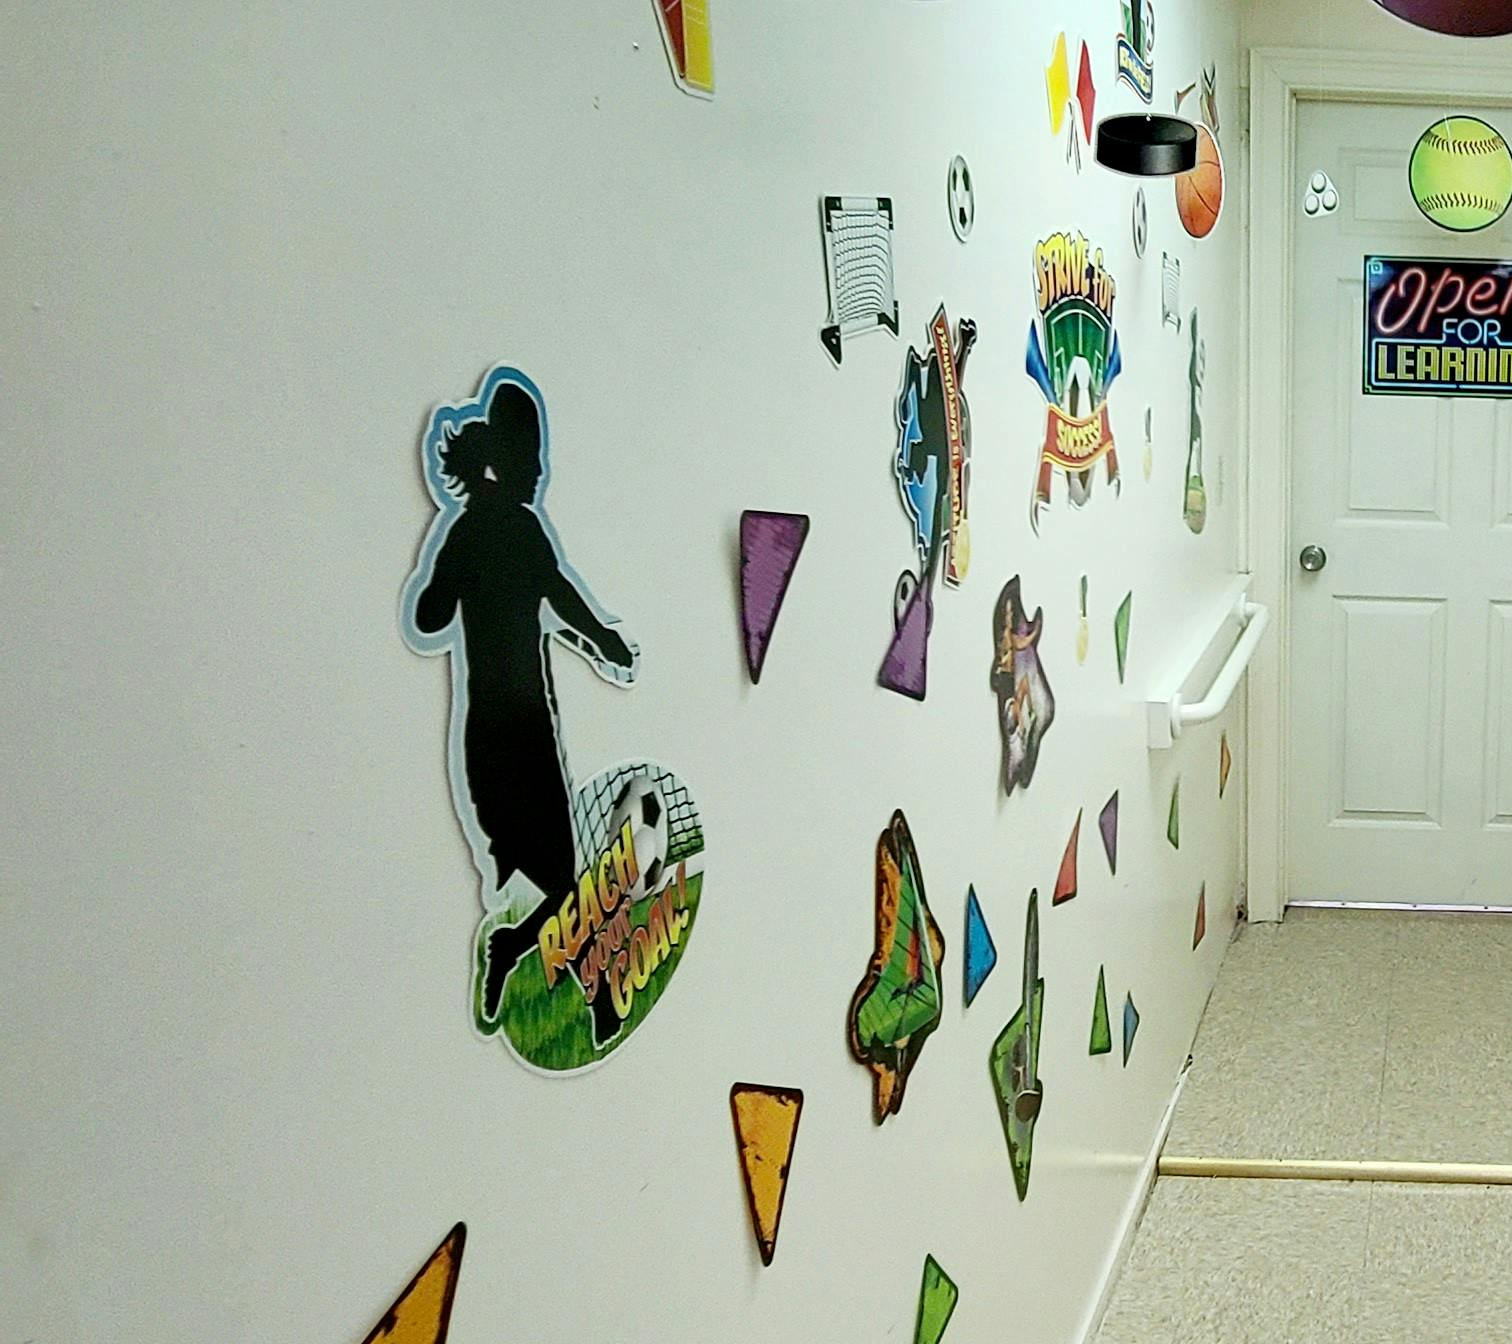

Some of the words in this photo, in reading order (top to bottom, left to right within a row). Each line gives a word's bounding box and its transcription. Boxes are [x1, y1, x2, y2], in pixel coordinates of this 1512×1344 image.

[1035, 230, 1090, 311] STRIVE
[1092, 247, 1117, 317] for
[1442, 318, 1502, 346] FOR
[537, 815, 640, 990] REACH
[579, 897, 631, 1005] your
[608, 859, 690, 1020] GOAL!
